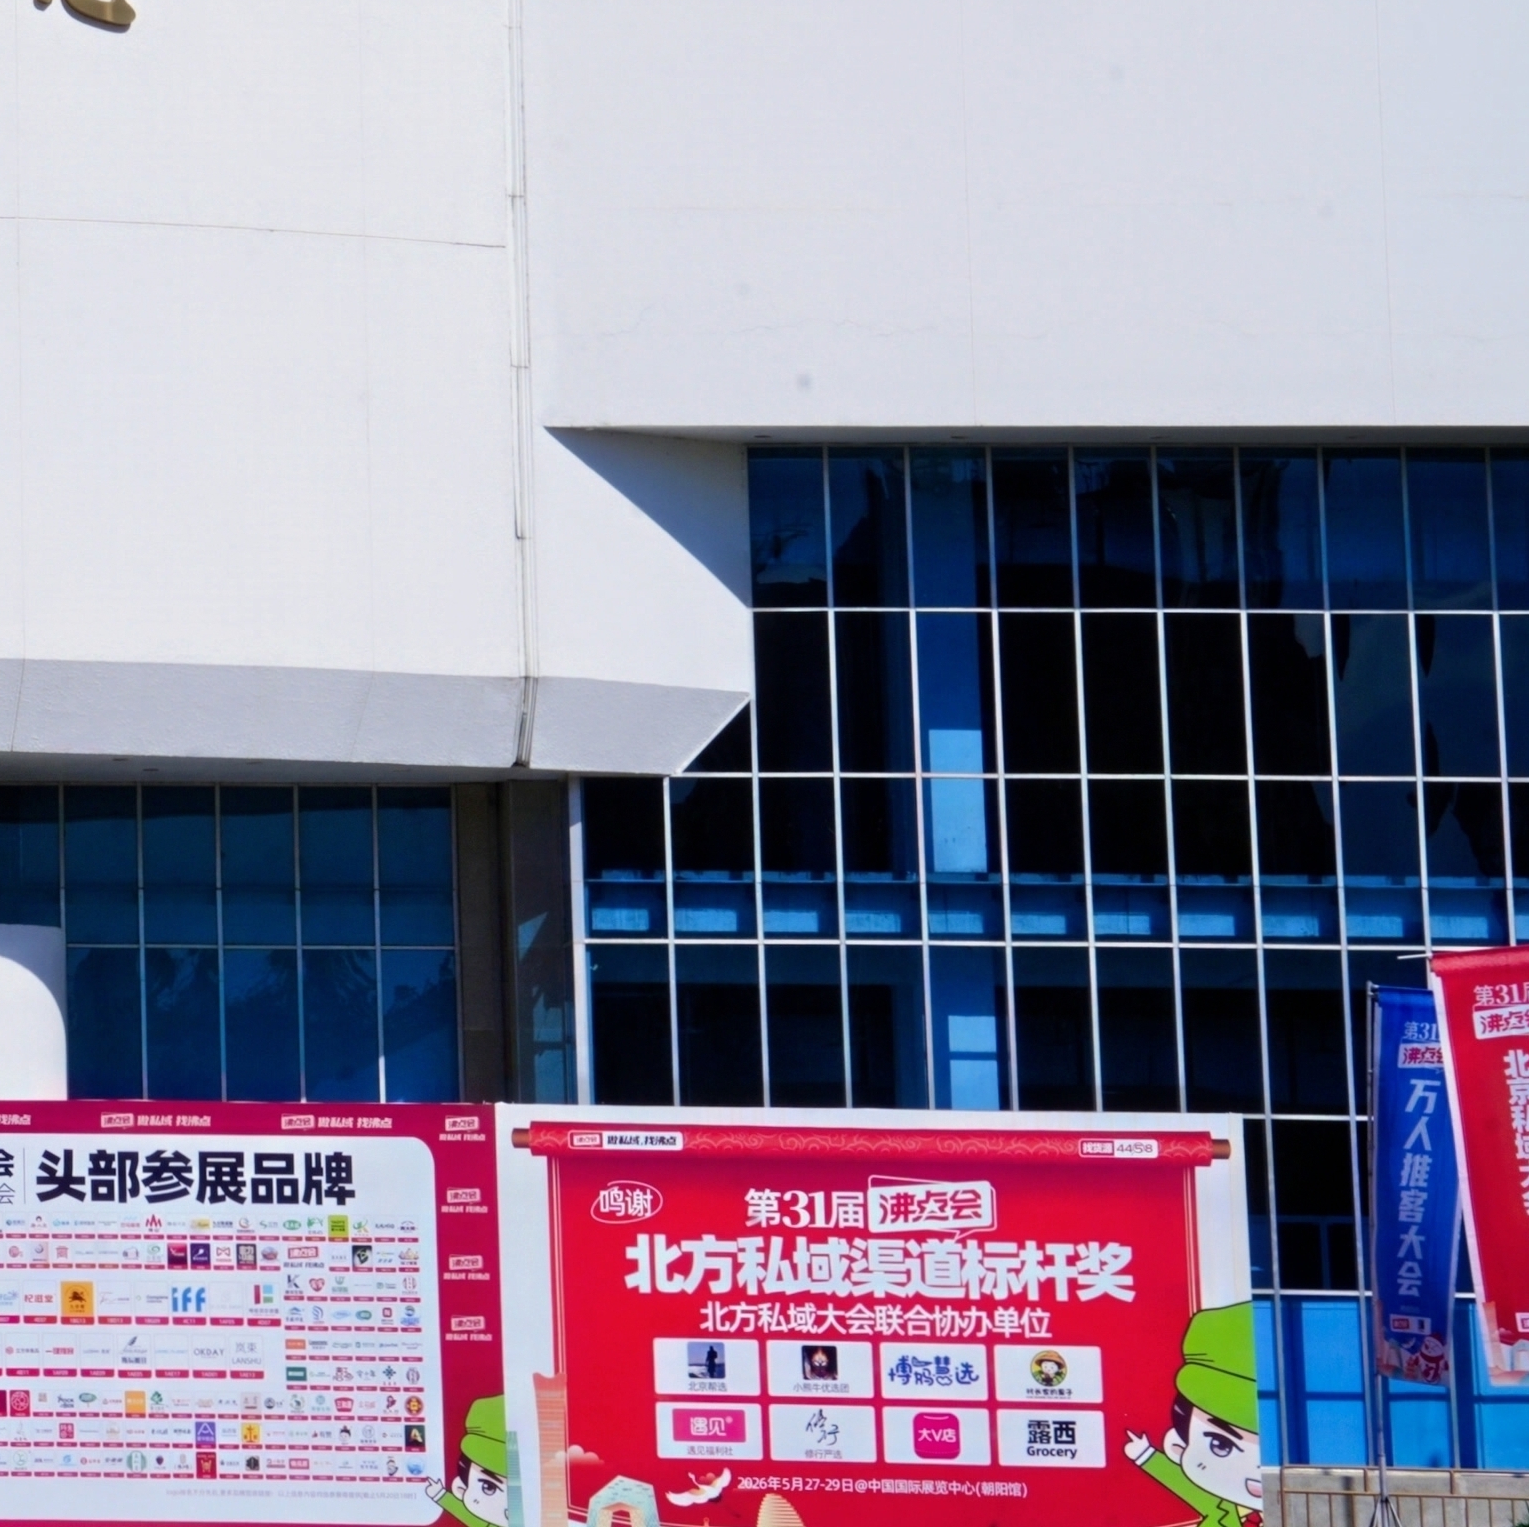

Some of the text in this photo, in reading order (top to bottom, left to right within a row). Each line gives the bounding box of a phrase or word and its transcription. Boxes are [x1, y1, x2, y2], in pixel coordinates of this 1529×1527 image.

[1404, 1021, 1440, 1041] 第31
[36, 1149, 356, 1206] 头部参展品牌
[1397, 1078, 1442, 1297] 万人推客大会
[599, 1186, 654, 1217] 鸣谢
[744, 1187, 984, 1229] 第31届 沸点会
[624, 1233, 1136, 1302] 北方私域渠道标杆奖
[700, 1301, 1053, 1339] 北方私域大会联合协办单位
[690, 1416, 727, 1436] 遇见
[917, 1427, 957, 1443] 大V店
[1027, 1419, 1077, 1445] 露西
[1026, 1445, 1078, 1460] Grocery
